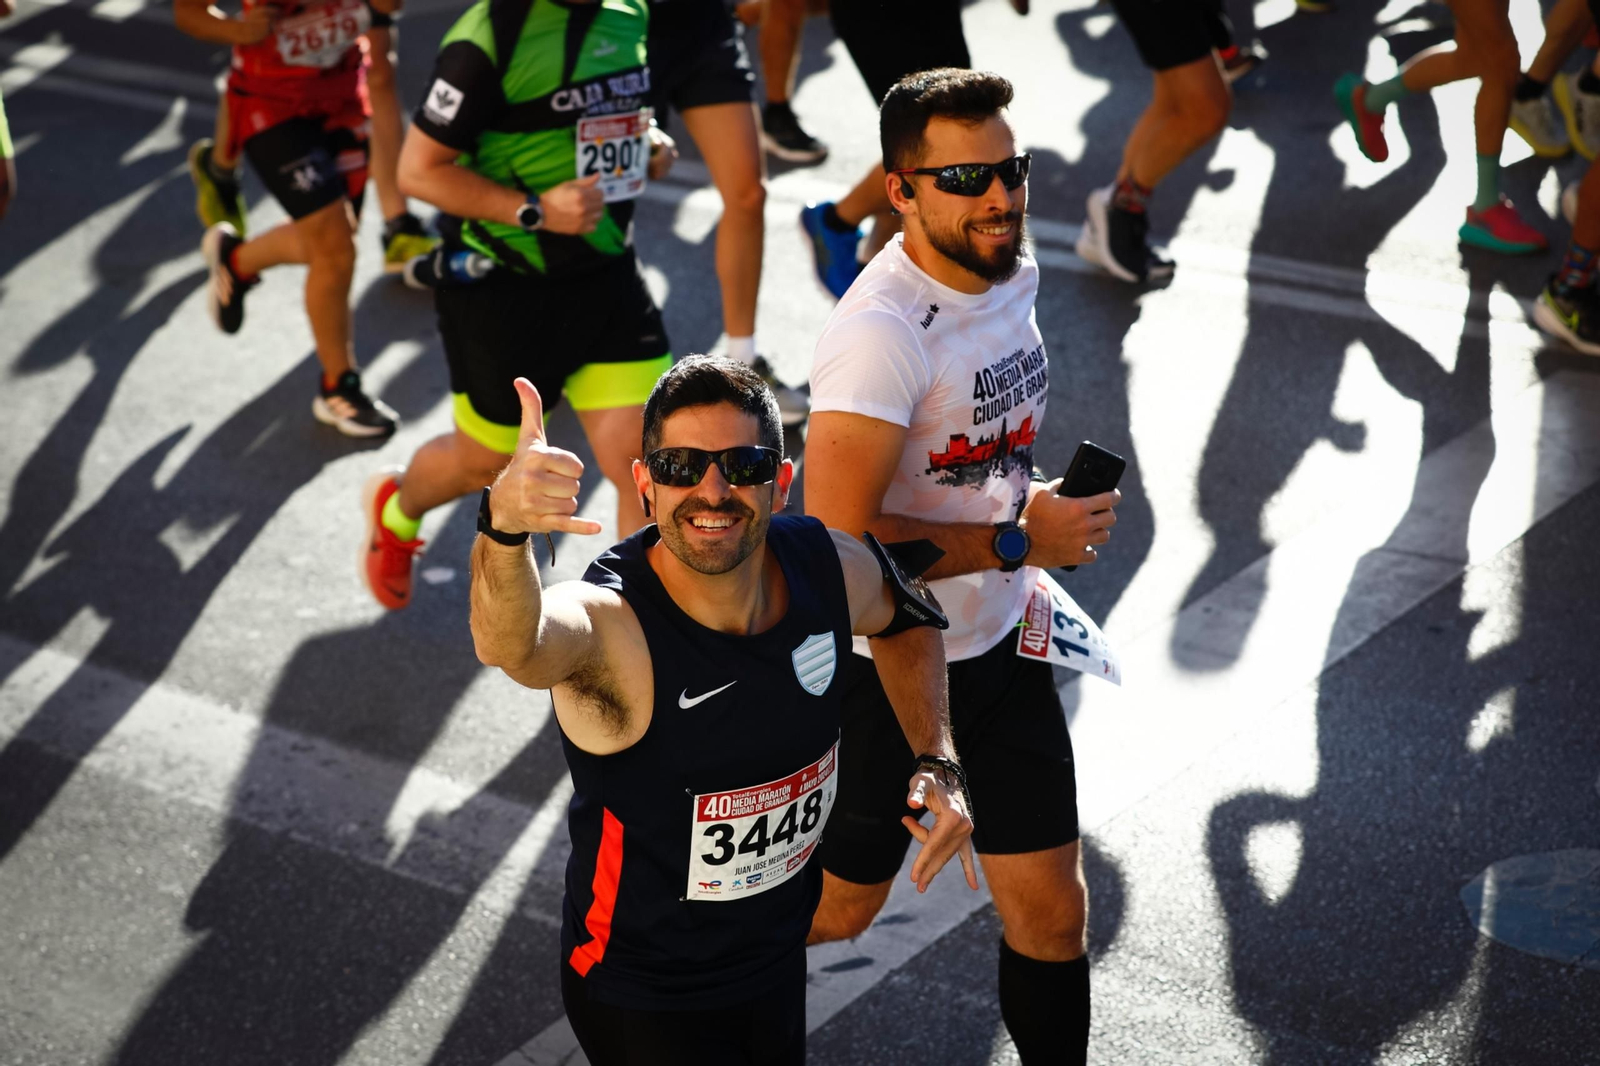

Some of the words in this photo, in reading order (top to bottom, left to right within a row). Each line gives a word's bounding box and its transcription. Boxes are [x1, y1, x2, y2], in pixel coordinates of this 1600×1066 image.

[288, 14, 358, 57] 2679
[991, 348, 1025, 374] TotalEnergies
[994, 363, 1023, 395] MEDIA
[1020, 344, 1047, 378] MARAT
[973, 367, 997, 402] 40
[973, 392, 1012, 426] CIUDAD
[1013, 383, 1025, 407] DE
[1025, 367, 1047, 399] GRAN
[1022, 629, 1047, 652] 40
[1052, 594, 1089, 658] 13
[703, 795, 732, 819] 40
[731, 796, 757, 809] MEDIA
[758, 784, 792, 803] MARATÓN
[731, 805, 754, 817] CIUDAD
[755, 803, 764, 812] DE
[764, 794, 791, 809] GRANADA
[732, 787, 771, 800] TotalEnergies
[701, 789, 823, 866] 3448
[734, 865, 752, 876] JUAN
[752, 860, 767, 872] JOSE
[768, 850, 790, 866] MEDINA
[790, 840, 805, 855] PEREZ
